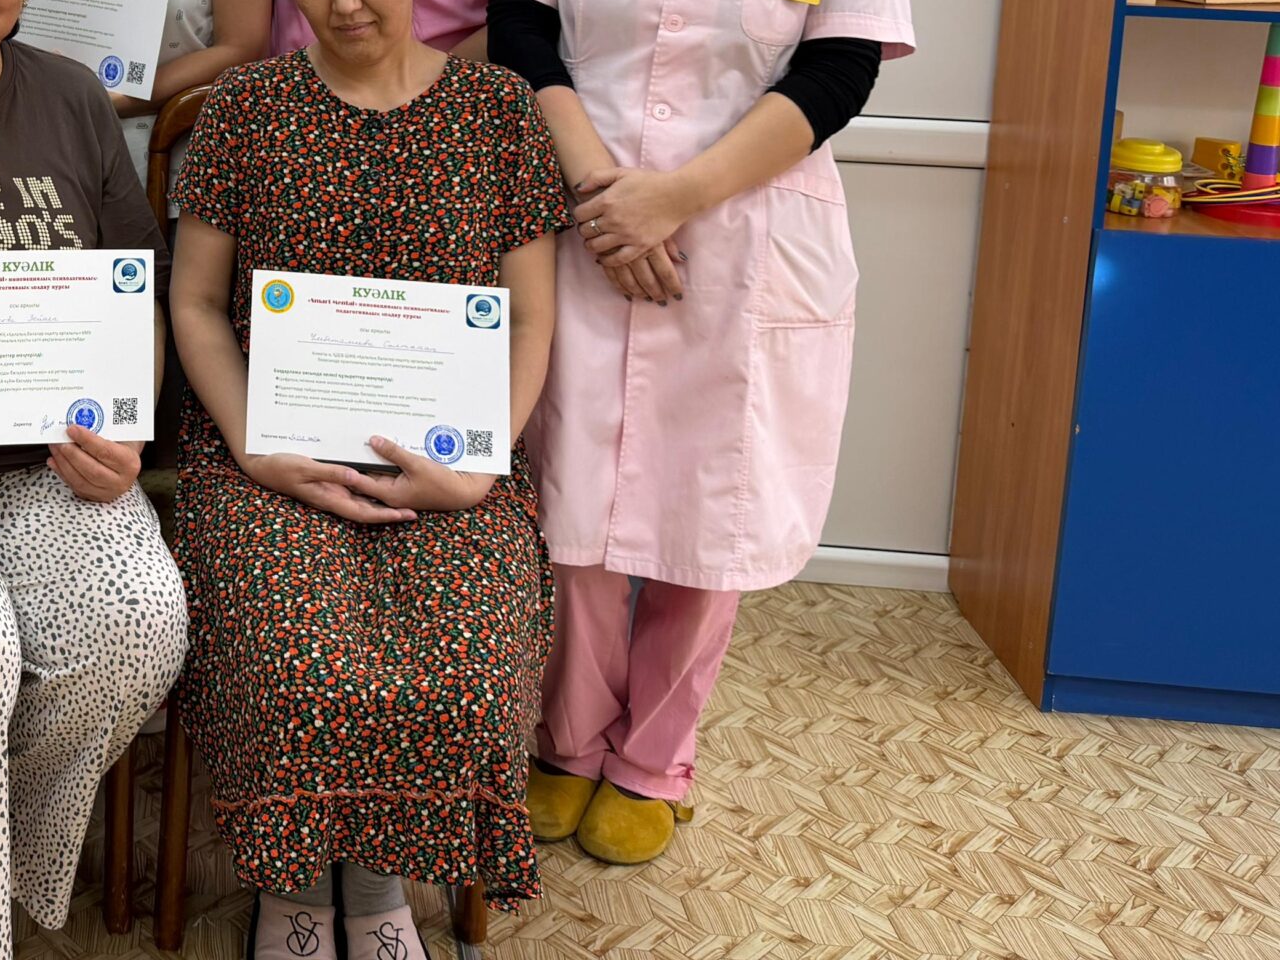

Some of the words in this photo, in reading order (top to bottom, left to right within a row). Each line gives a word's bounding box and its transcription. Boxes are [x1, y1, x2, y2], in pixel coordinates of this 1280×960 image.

[13, 176, 63, 209] IN
[3, 261, 55, 273] КУӘЛІК
[352, 287, 406, 301] КУӘЛІК
